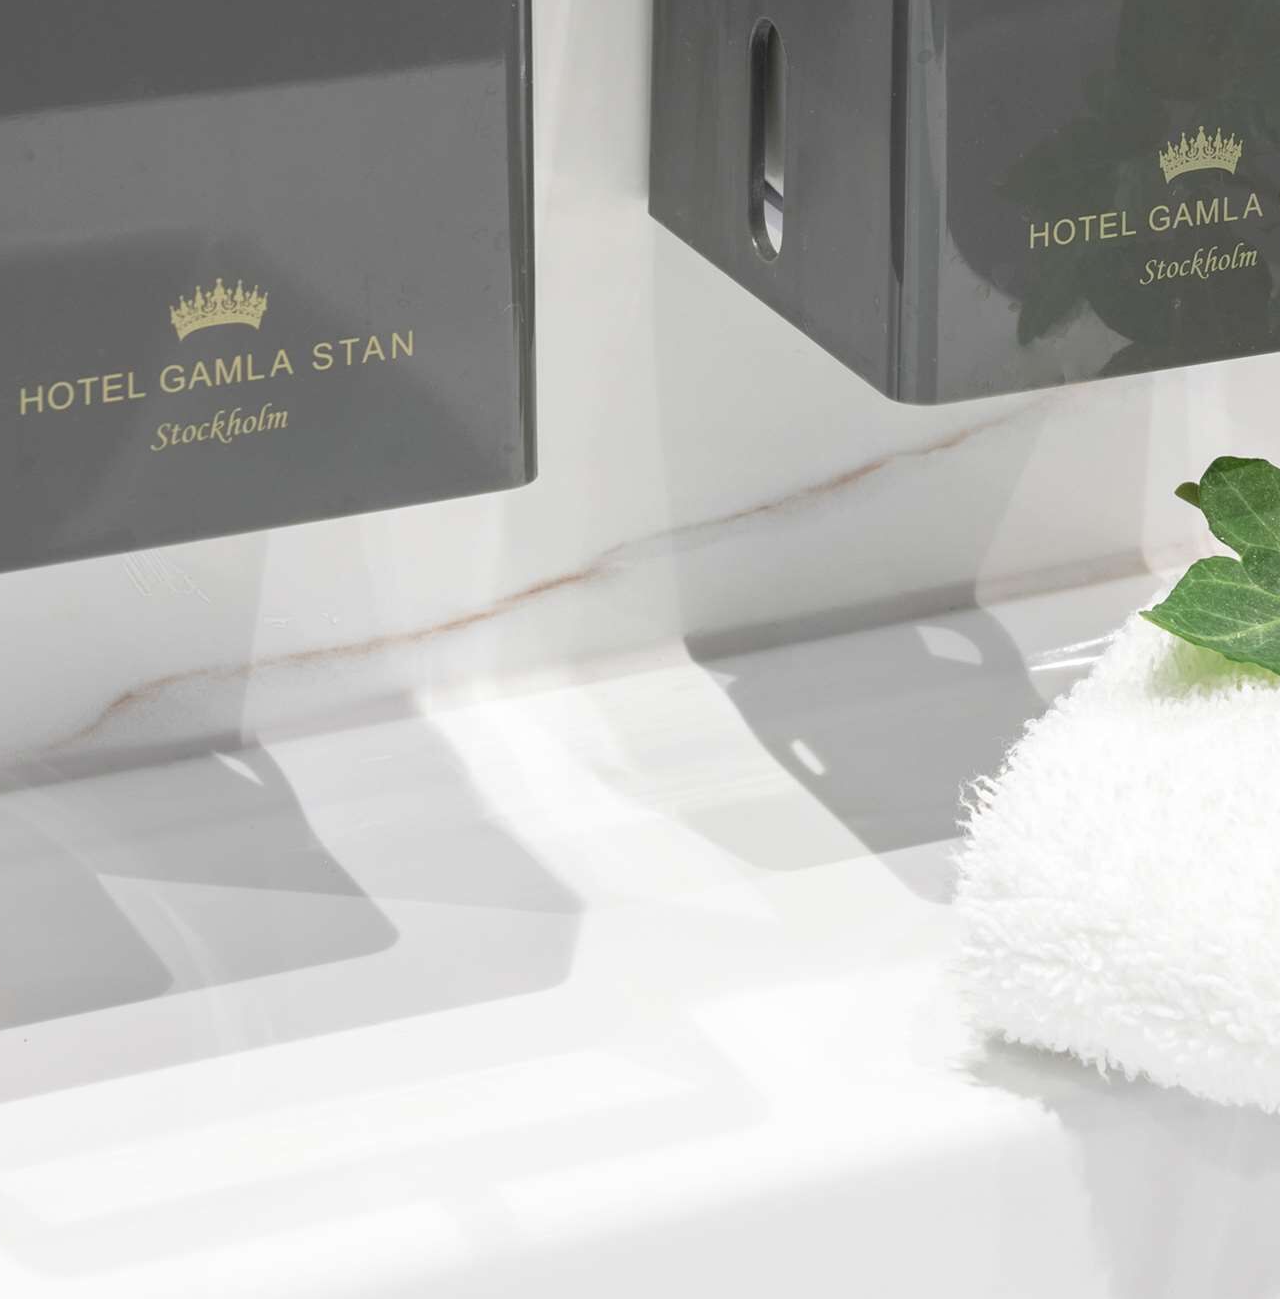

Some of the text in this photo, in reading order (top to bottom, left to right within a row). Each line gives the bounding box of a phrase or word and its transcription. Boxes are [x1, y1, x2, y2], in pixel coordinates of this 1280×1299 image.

[1029, 210, 1137, 250] HOTEL
[1148, 192, 1264, 232] GAMLA
[1139, 242, 1258, 286] Stockholm
[20, 329, 414, 416] HOTEL GAMLA STAN
[150, 402, 289, 452] Stockholm
